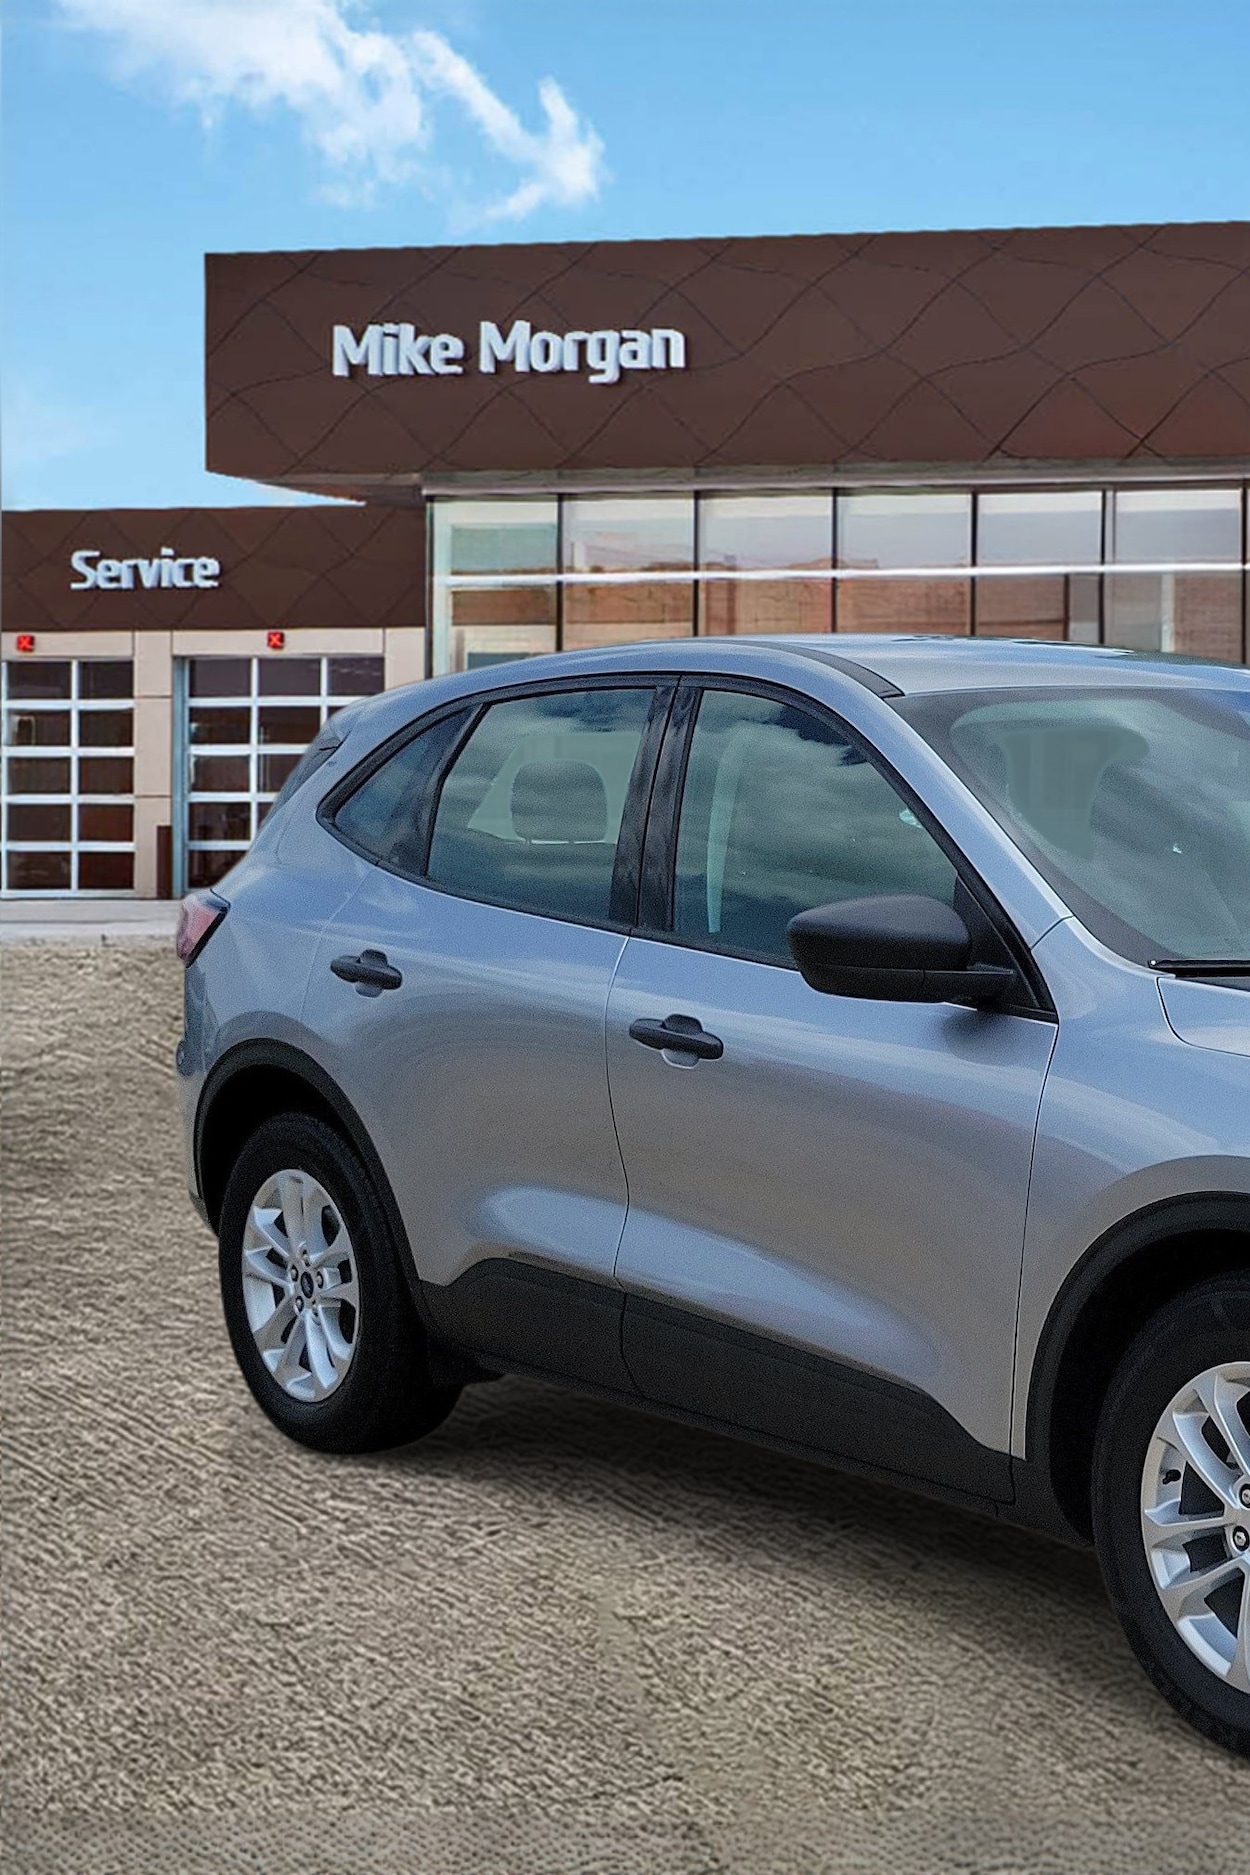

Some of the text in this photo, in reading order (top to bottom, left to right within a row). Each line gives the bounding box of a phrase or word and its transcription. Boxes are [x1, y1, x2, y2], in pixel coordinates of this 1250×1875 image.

[332, 319, 686, 384] Mike Morgan
[70, 547, 221, 590] Service
